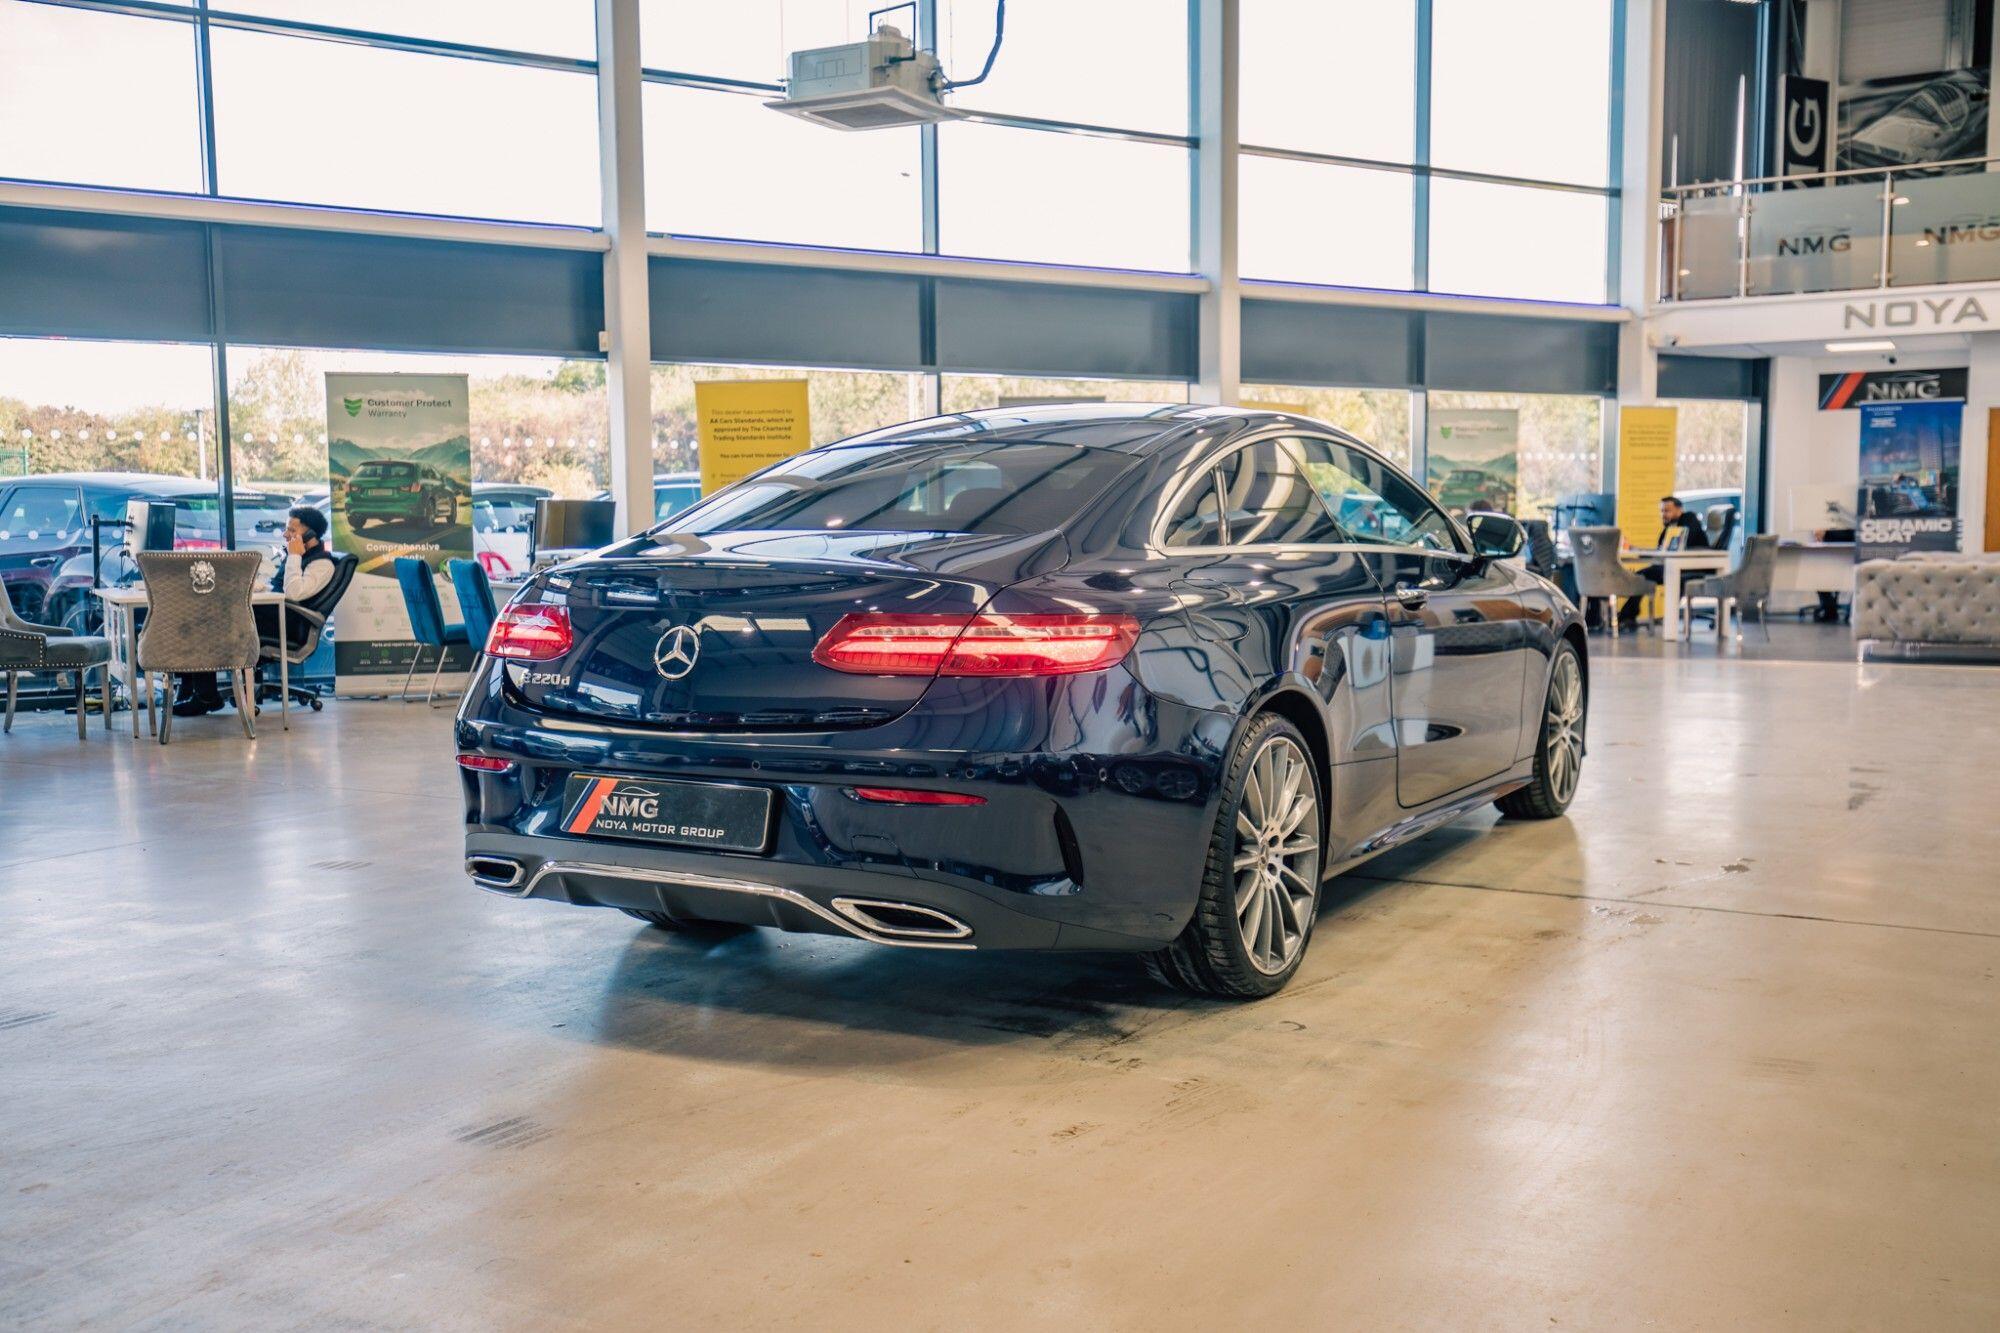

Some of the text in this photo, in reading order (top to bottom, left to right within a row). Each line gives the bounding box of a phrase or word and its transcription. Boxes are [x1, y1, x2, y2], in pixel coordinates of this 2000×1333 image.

[1924, 222, 2000, 245] NMG
[1778, 234, 1851, 256] NMG
[1844, 297, 1988, 330] NOYA
[1866, 380, 1941, 400] NMG
[367, 399, 452, 407] Customer Protect
[368, 410, 407, 418] Warranty
[1860, 519, 1953, 532] CERAMIC
[1860, 530, 1915, 543] COAT
[366, 542, 440, 552] Comprehensive
[600, 795, 659, 818] NMG
[596, 819, 725, 839] NOYA MOTOR GROUP
